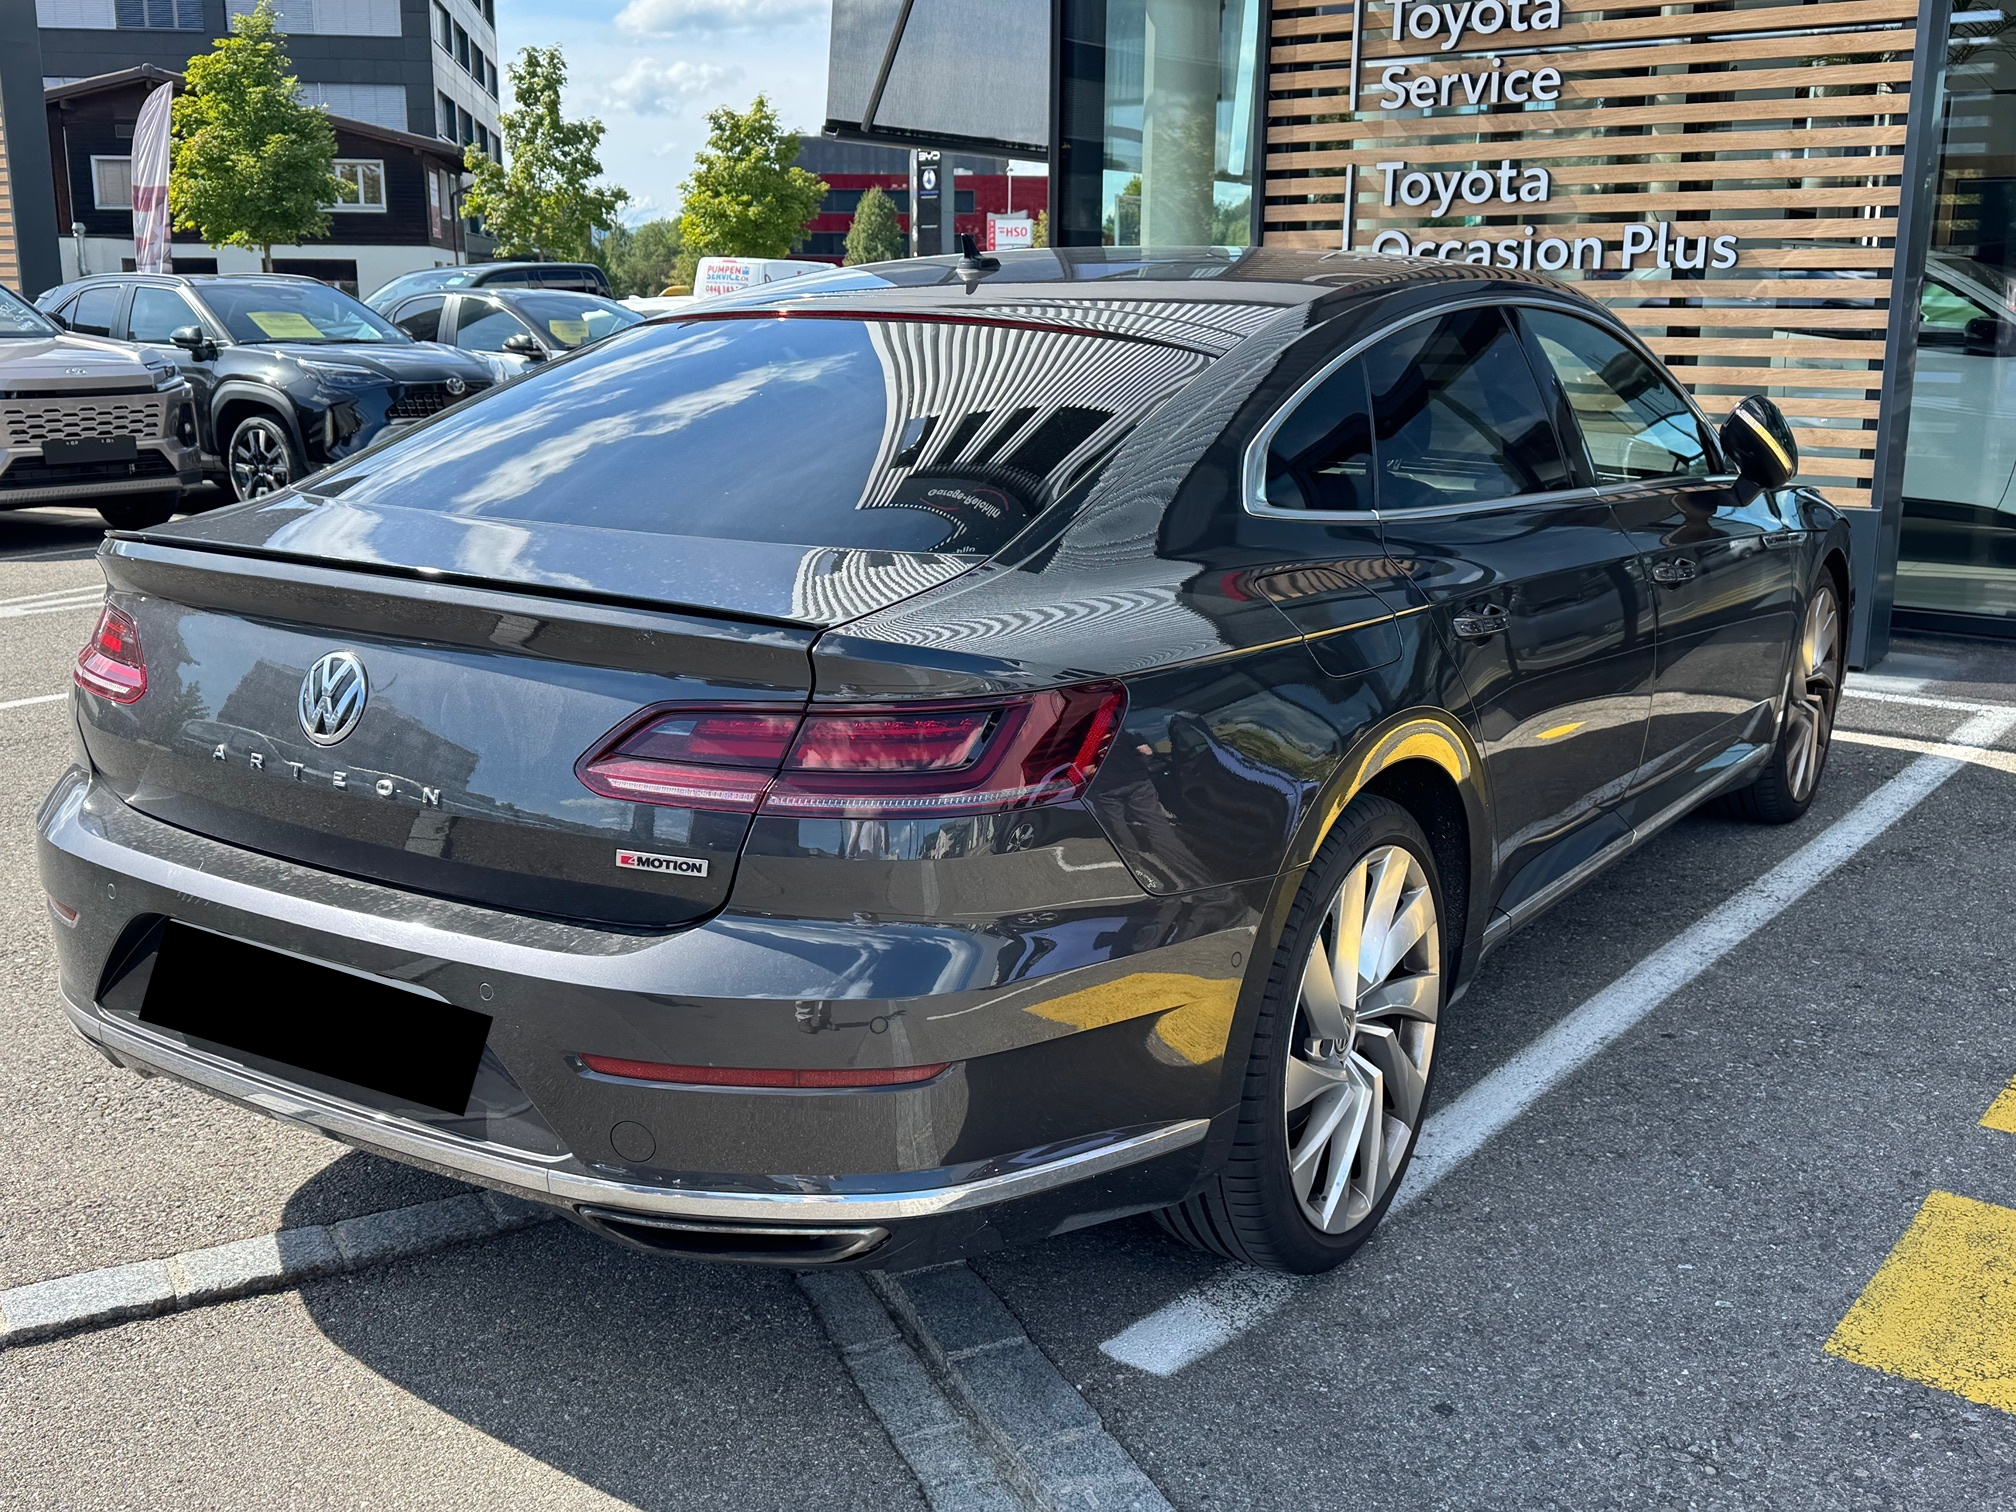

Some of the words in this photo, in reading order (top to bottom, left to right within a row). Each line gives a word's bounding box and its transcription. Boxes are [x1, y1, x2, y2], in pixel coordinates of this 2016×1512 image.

[1384, 0, 1562, 50] Toyota
[1380, 57, 1562, 109] Service
[919, 151, 940, 160] BYD
[1376, 159, 1551, 217] Toyota
[1006, 227, 1028, 237] HSO
[1621, 222, 1738, 269] Plus
[707, 265, 741, 274] PUMPEN
[212, 743, 442, 805] ARTEON
[620, 854, 702, 873] 4MOTION
